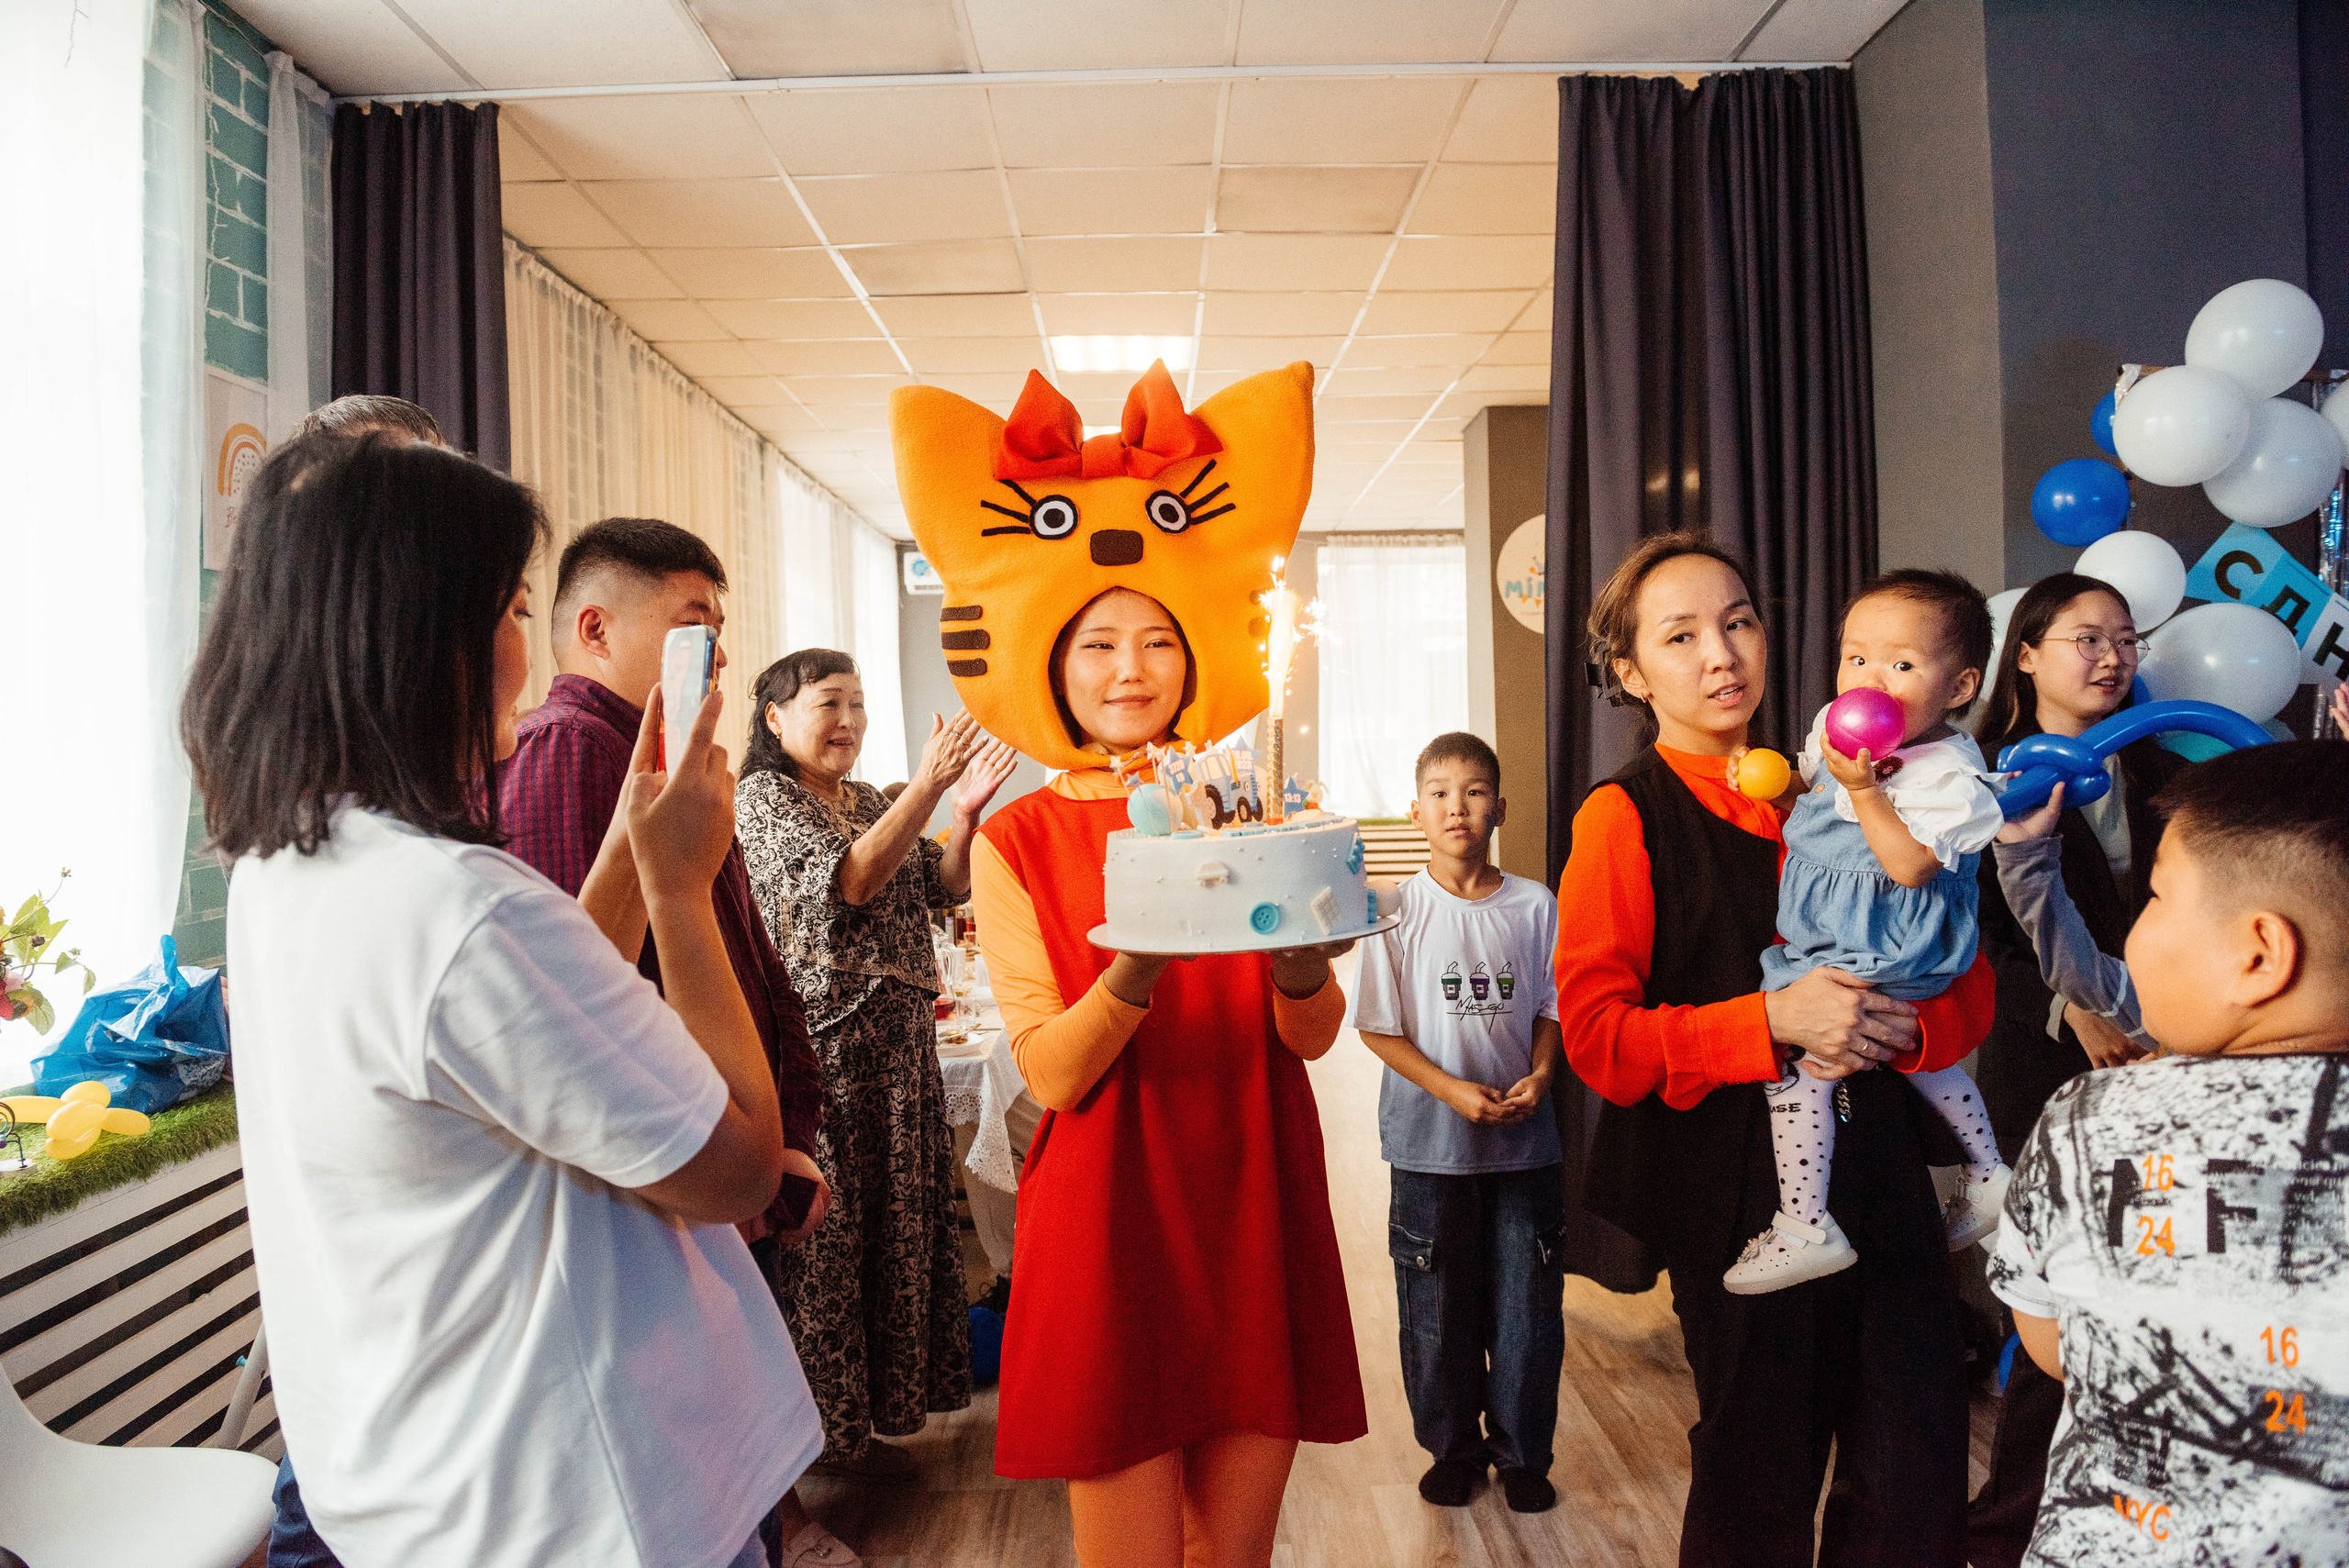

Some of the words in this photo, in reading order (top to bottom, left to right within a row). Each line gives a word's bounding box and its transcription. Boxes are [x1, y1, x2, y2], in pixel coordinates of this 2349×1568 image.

[2142, 1153, 2175, 1192] 16
[2136, 1215, 2176, 1257] 24
[2259, 1326, 2299, 1368] 16
[2265, 1389, 2308, 1434] 24
